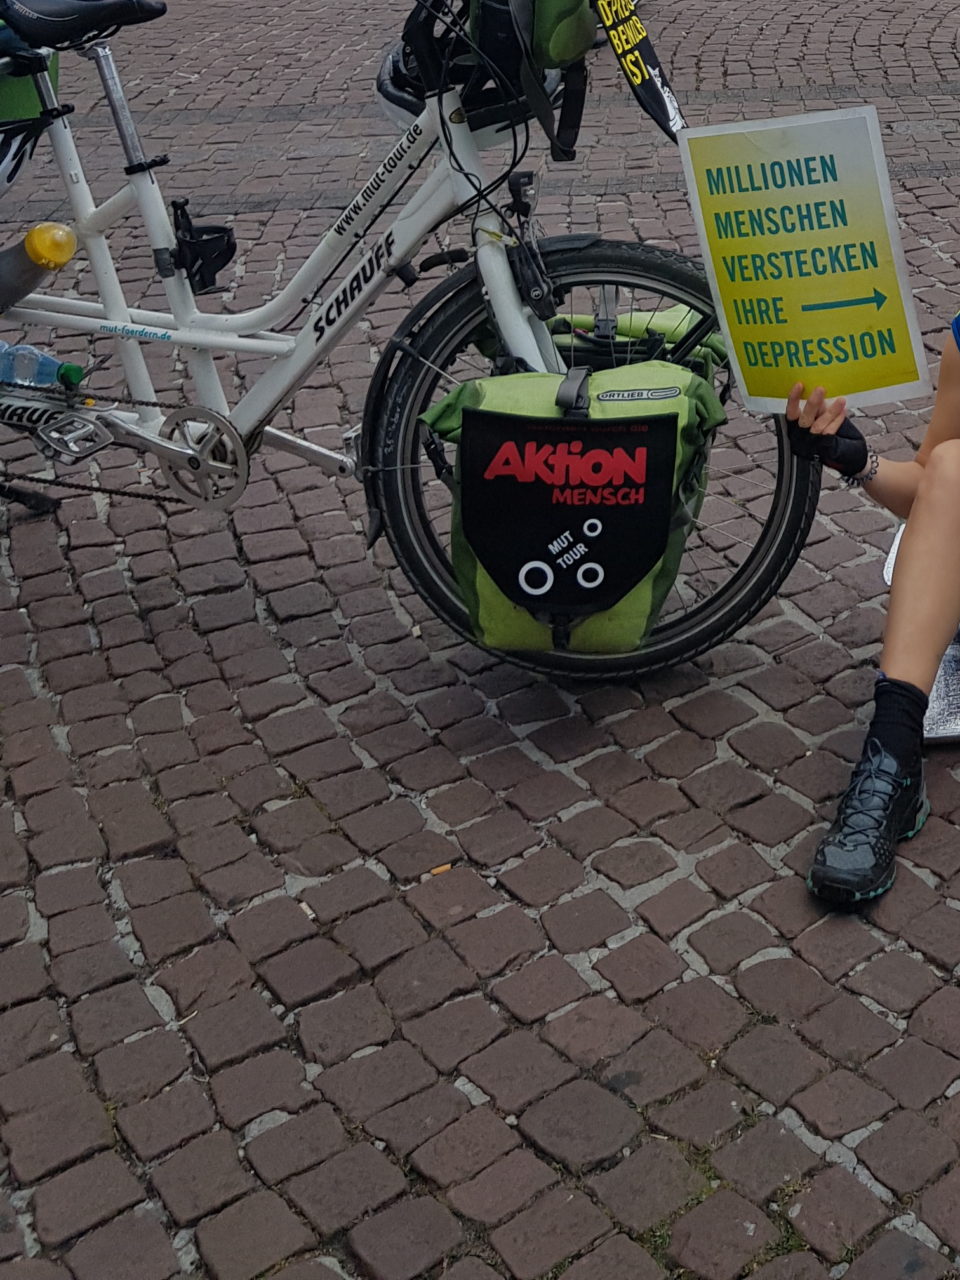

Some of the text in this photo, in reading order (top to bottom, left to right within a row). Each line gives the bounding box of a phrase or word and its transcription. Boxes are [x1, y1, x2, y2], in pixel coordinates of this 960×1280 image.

[333, 122, 423, 237] www.mut-tour.de
[705, 154, 838, 196] MILLIONEN
[713, 198, 849, 239] MENSCHEN
[721, 240, 879, 283] VERSTECKEN
[313, 230, 396, 344] SCHAUFF
[733, 296, 788, 325] IHRE
[100, 322, 173, 342] mut-foerdern.de
[743, 327, 896, 369] DEPRESSION
[601, 390, 645, 400] ORTLIEB
[551, 487, 645, 506] MENSCH
[547, 529, 574, 556] MUT
[556, 542, 589, 570] TOUR
